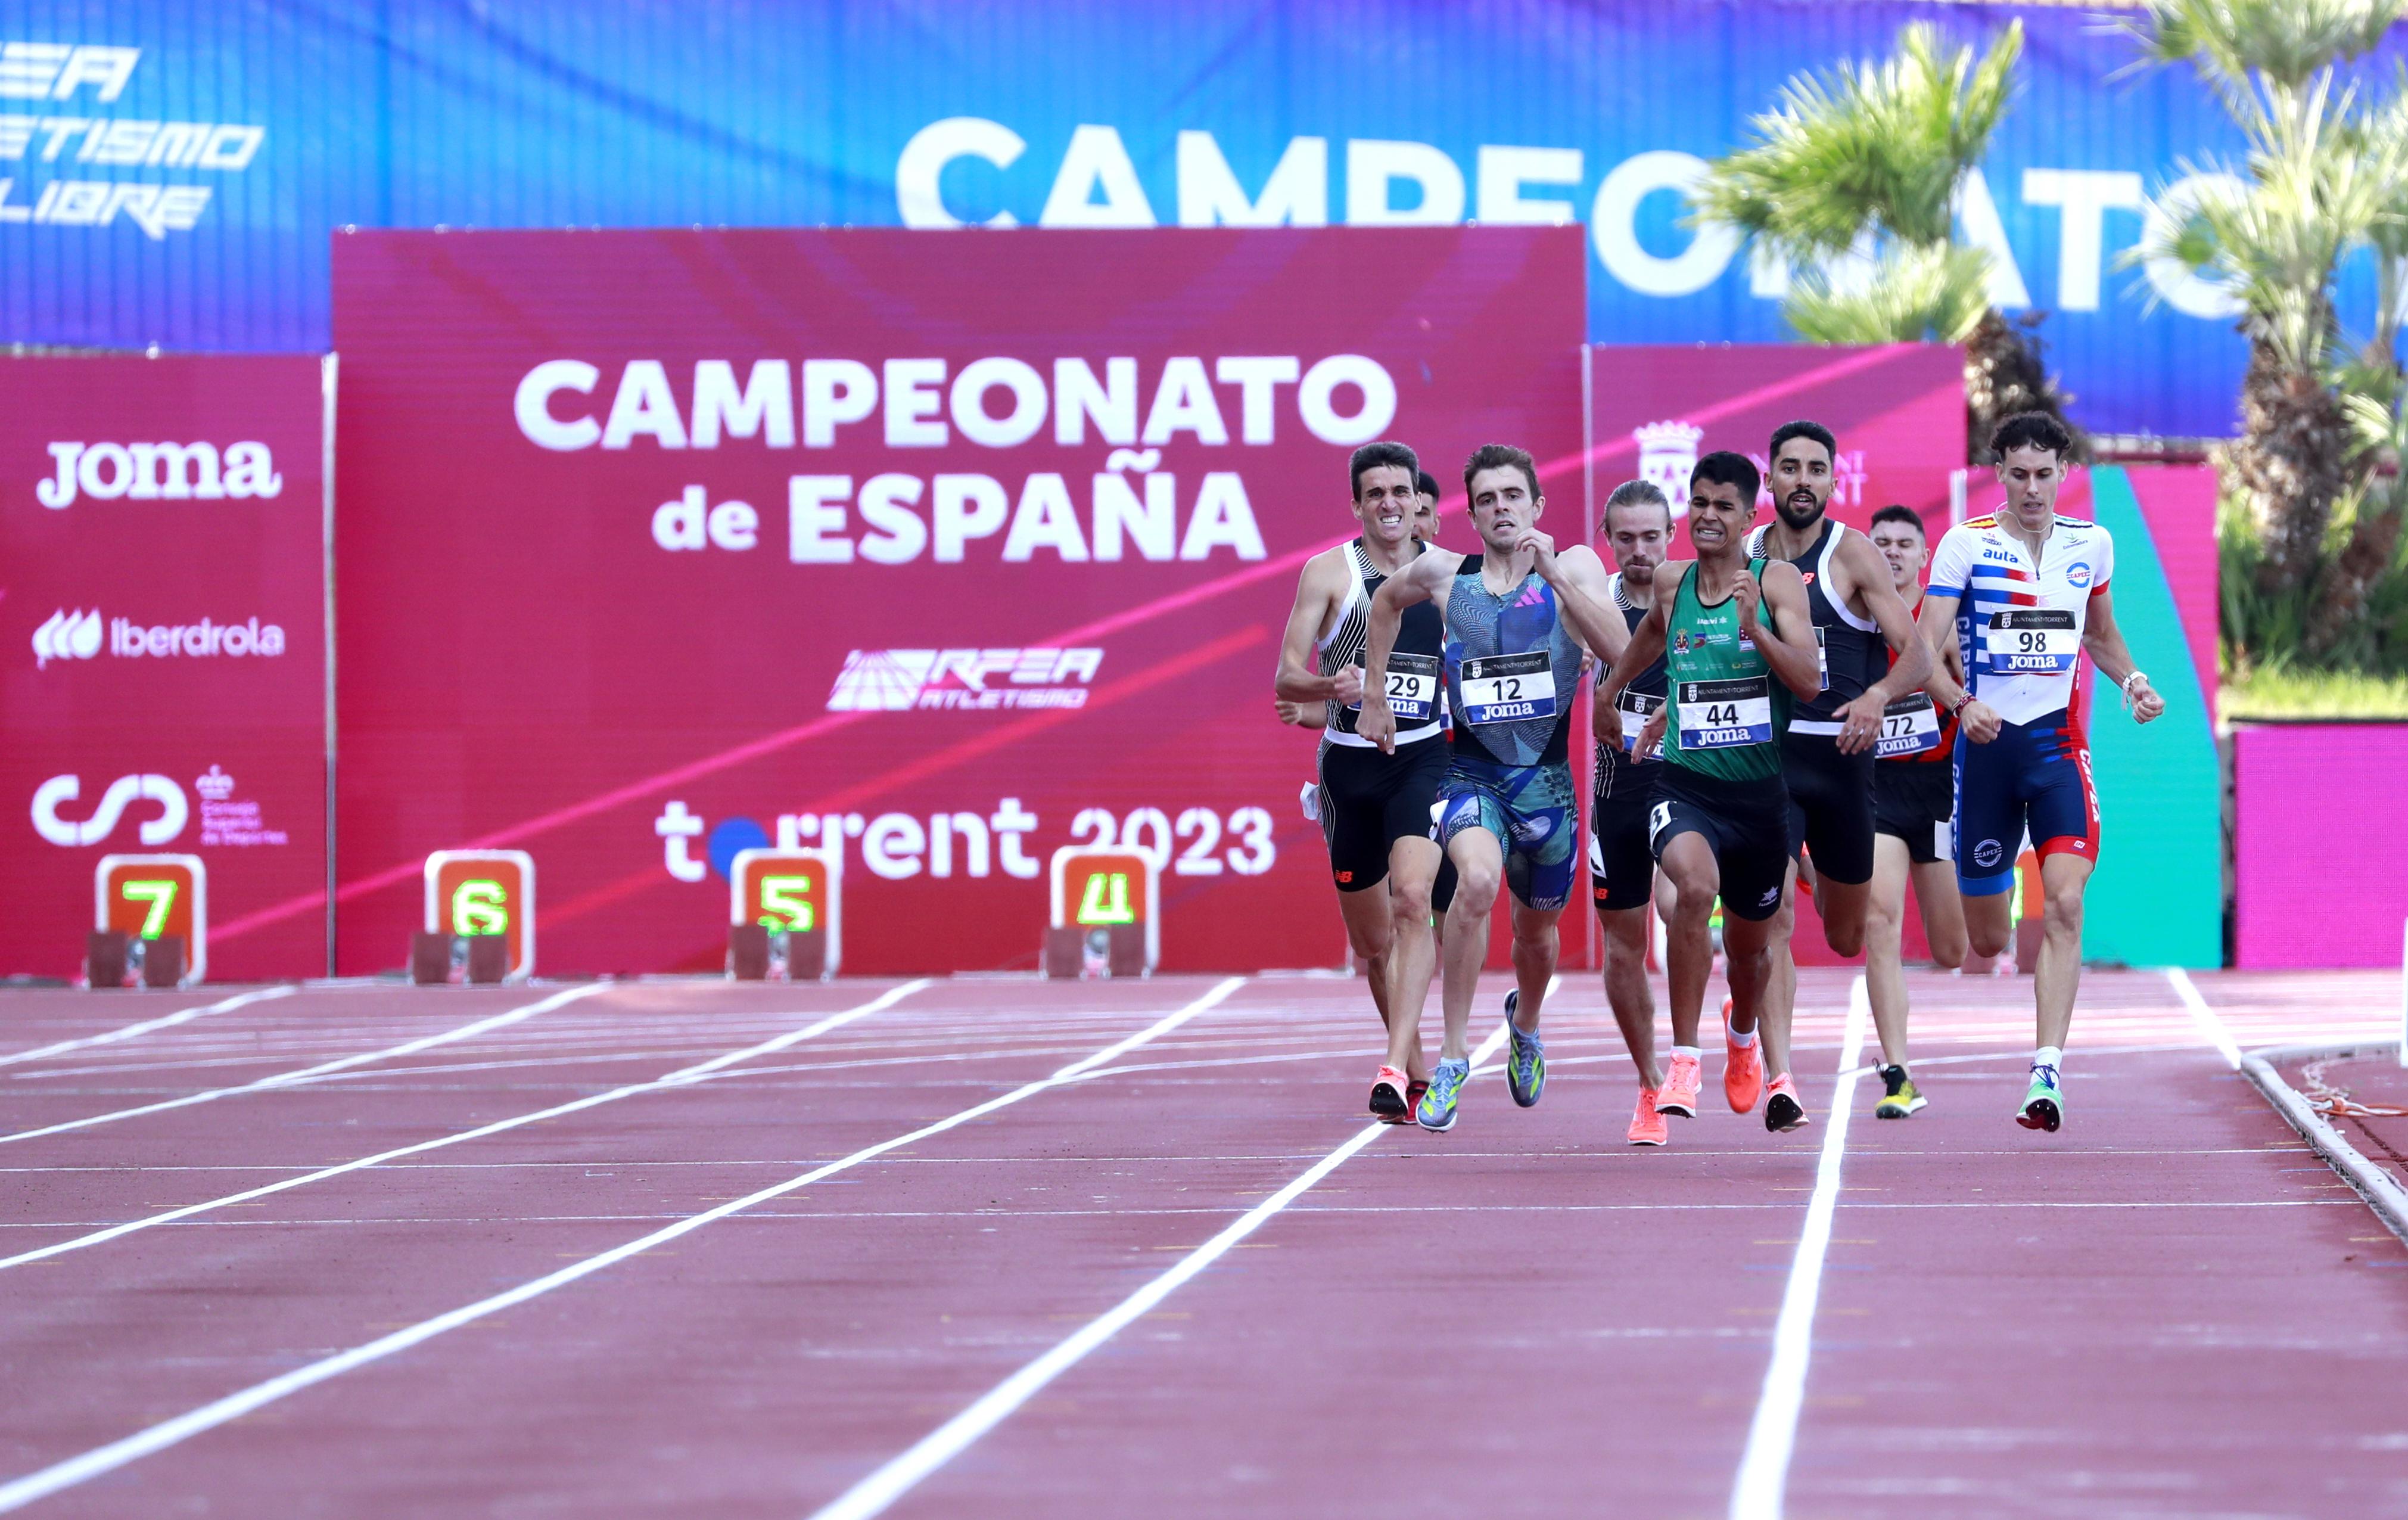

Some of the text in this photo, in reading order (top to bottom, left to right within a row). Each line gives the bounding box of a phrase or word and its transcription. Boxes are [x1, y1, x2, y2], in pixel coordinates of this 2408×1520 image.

[514, 355, 1397, 450] CAMPEONATO
[651, 448, 1267, 565] de ESPAÑA
[1983, 549, 2018, 563] aula
[111, 617, 285, 656] Iberdrola
[2019, 632, 2046, 652] 98
[928, 648, 1104, 692] RFEA
[1386, 676, 1420, 697] 29
[1492, 678, 1522, 701] 12
[919, 688, 1088, 710] ATLETISMO
[1707, 704, 1738, 726] 44
[123, 880, 178, 940] 7
[452, 879, 508, 937] 6
[757, 875, 814, 937] 5
[1077, 872, 1134, 924] 4
